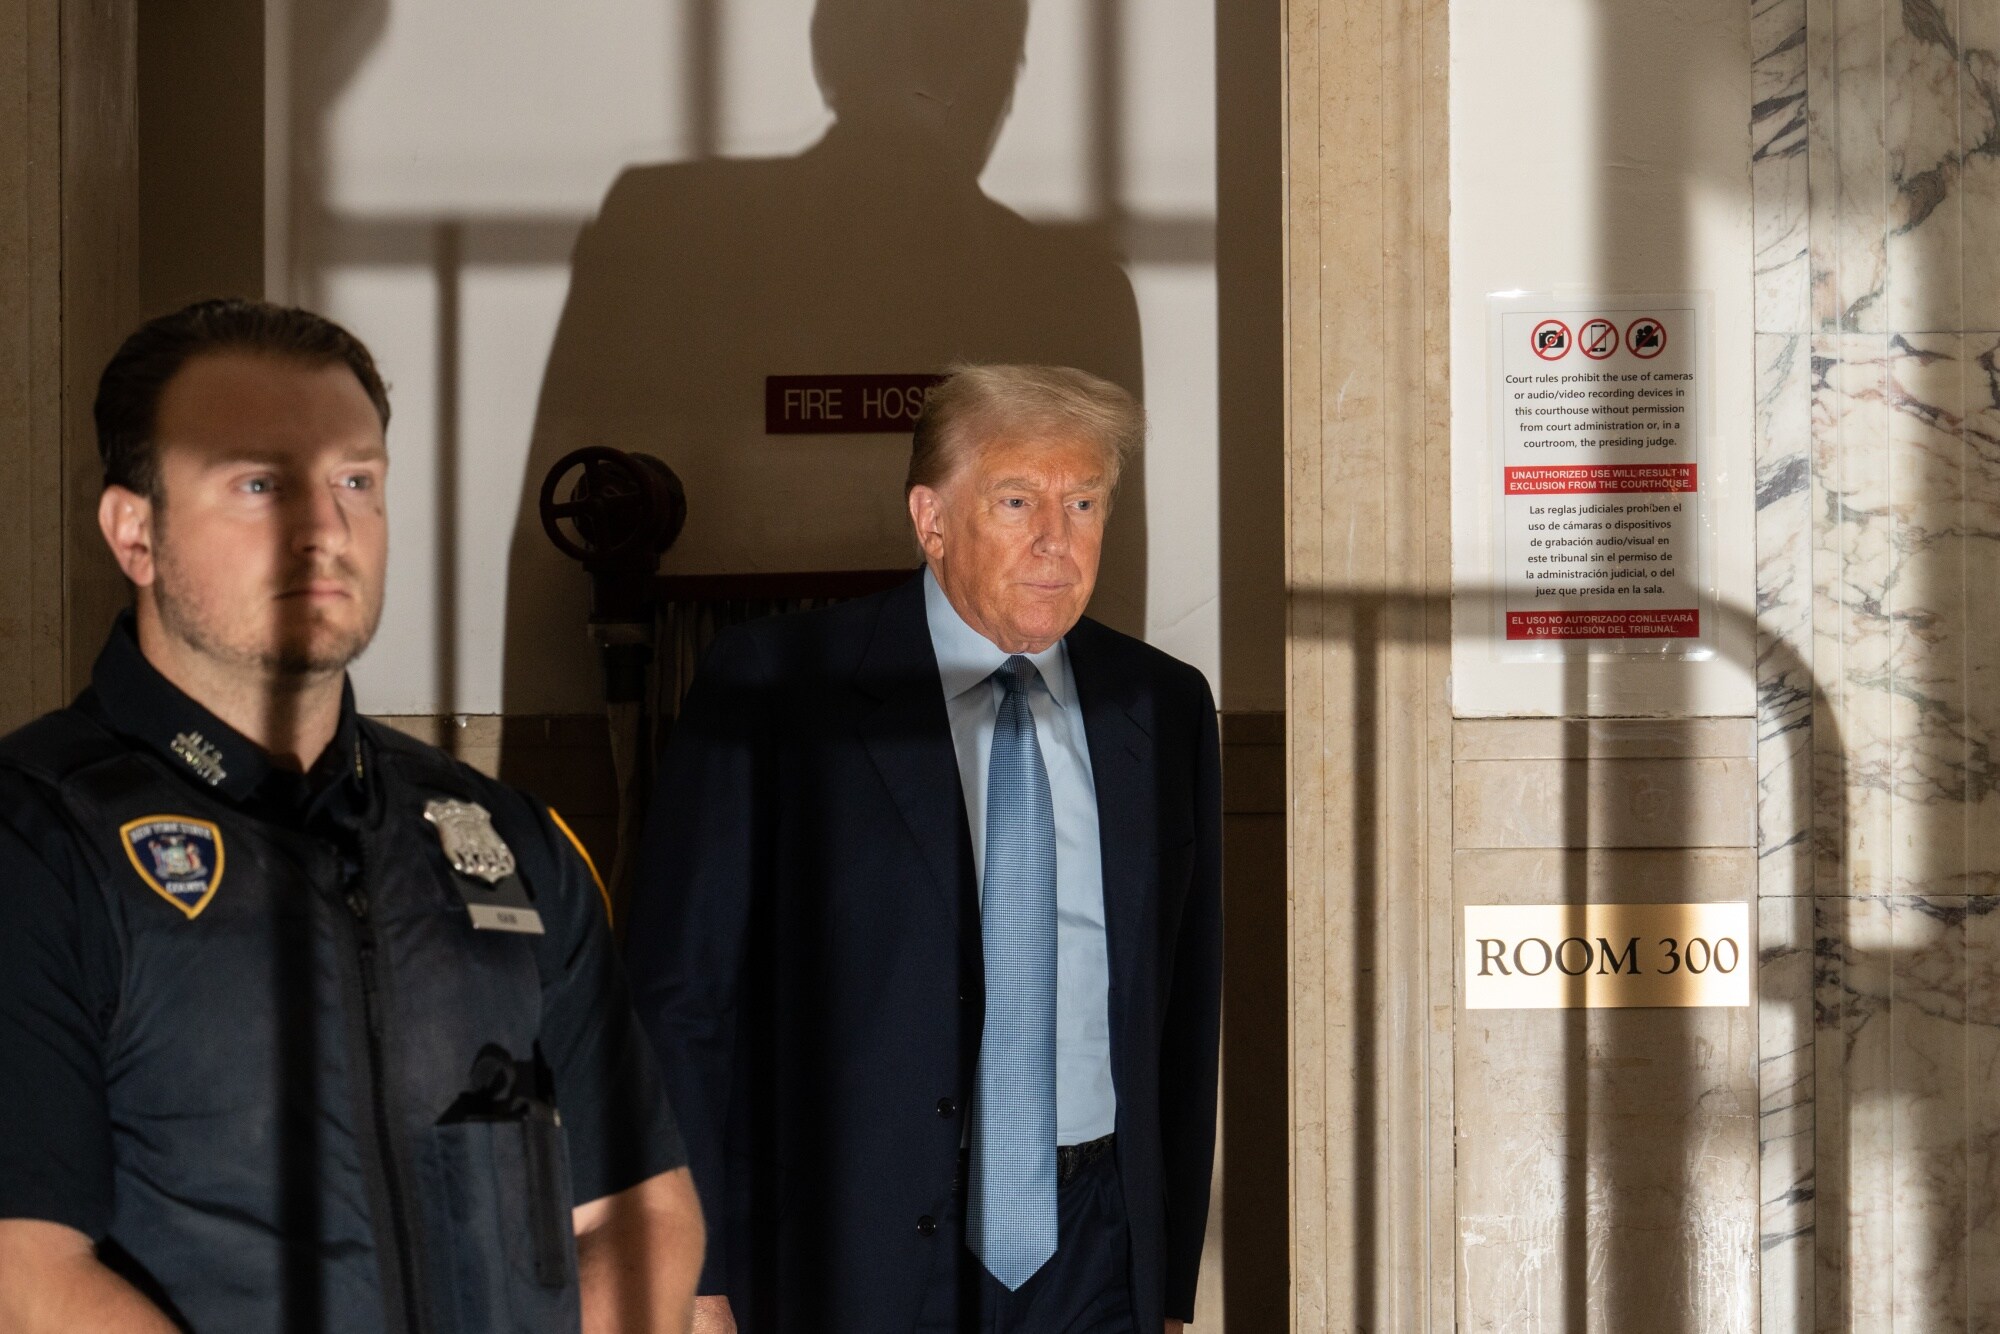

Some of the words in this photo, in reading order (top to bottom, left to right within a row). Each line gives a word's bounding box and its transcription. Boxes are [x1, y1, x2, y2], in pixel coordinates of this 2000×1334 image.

[1505, 374, 1532, 383] Court
[1535, 374, 1559, 383] rules
[1562, 373, 1600, 384] prohibit
[1603, 373, 1618, 382] the
[1641, 372, 1651, 381] of
[1653, 372, 1693, 381] cameras
[1514, 391, 1525, 400] or
[1527, 390, 1585, 400] audio/video
[1588, 389, 1634, 400] recording
[1637, 388, 1673, 397] devices
[1676, 388, 1685, 397] in
[784, 389, 843, 420] FIRE
[863, 386, 926, 420] HOS
[1515, 407, 1532, 416] this
[1535, 406, 1589, 415] courthouse
[1592, 405, 1629, 414] without
[1632, 405, 1685, 415] permission
[1520, 422, 1543, 432] from
[1546, 423, 1571, 431] court
[1574, 421, 1644, 431] administration
[1647, 421, 1660, 431] or,
[1662, 421, 1673, 429] in
[1523, 439, 1578, 448] courtroom,
[1580, 438, 1596, 447] the
[1599, 437, 1644, 448] presiding
[1646, 436, 1677, 447] judge.
[1512, 470, 1588, 480] UNAUTHORIZED
[1591, 470, 1610, 478] USE
[1613, 469, 1636, 478] WILL
[1639, 469, 1675, 477] RESULT
[1510, 481, 1566, 491] EXCLUSION
[1568, 481, 1597, 490] FROM
[1599, 480, 1618, 489] THE
[1620, 479, 1692, 489] COURTHOUSE.
[1529, 505, 1545, 514] Las
[1547, 505, 1577, 516] reglas
[1579, 504, 1624, 515] judiciales
[1673, 503, 1682, 512] el
[1528, 522, 1545, 531] uso
[1548, 521, 1560, 530] de
[1563, 521, 1602, 530] cámaras
[1614, 520, 1671, 531] dispositivos
[1530, 537, 1542, 546] de
[1545, 537, 1593, 549] grabación
[1596, 536, 1655, 546] audio/visual
[1657, 537, 1669, 545] en
[1528, 554, 1547, 563] este
[1550, 554, 1588, 562] tribunal
[1590, 553, 1604, 562] sin
[1607, 553, 1615, 562] el
[1618, 553, 1657, 563] permiso
[1660, 552, 1673, 560] de
[1526, 570, 1534, 579] la
[1537, 570, 1608, 579] administración
[1610, 569, 1648, 580] judicial,
[1660, 568, 1675, 577] del
[1535, 587, 1556, 597] juez
[1559, 587, 1577, 596] que
[1580, 586, 1615, 596] presida
[1633, 585, 1641, 594] la
[1643, 585, 1665, 594] sala.
[1512, 616, 1524, 625] EL
[1526, 616, 1547, 624] USO
[1549, 616, 1563, 624] NO
[1565, 615, 1627, 624] AUTORIZADO
[1629, 613, 1693, 623] CONLLEVARÁ
[1536, 626, 1549, 634] SU
[1551, 624, 1606, 634] EXCLUSIÓN
[1608, 625, 1627, 633] DEL
[1629, 624, 1679, 633] TRIBUNAL.
[1476, 936, 1642, 977] ROOM
[1656, 936, 1740, 976] 300
